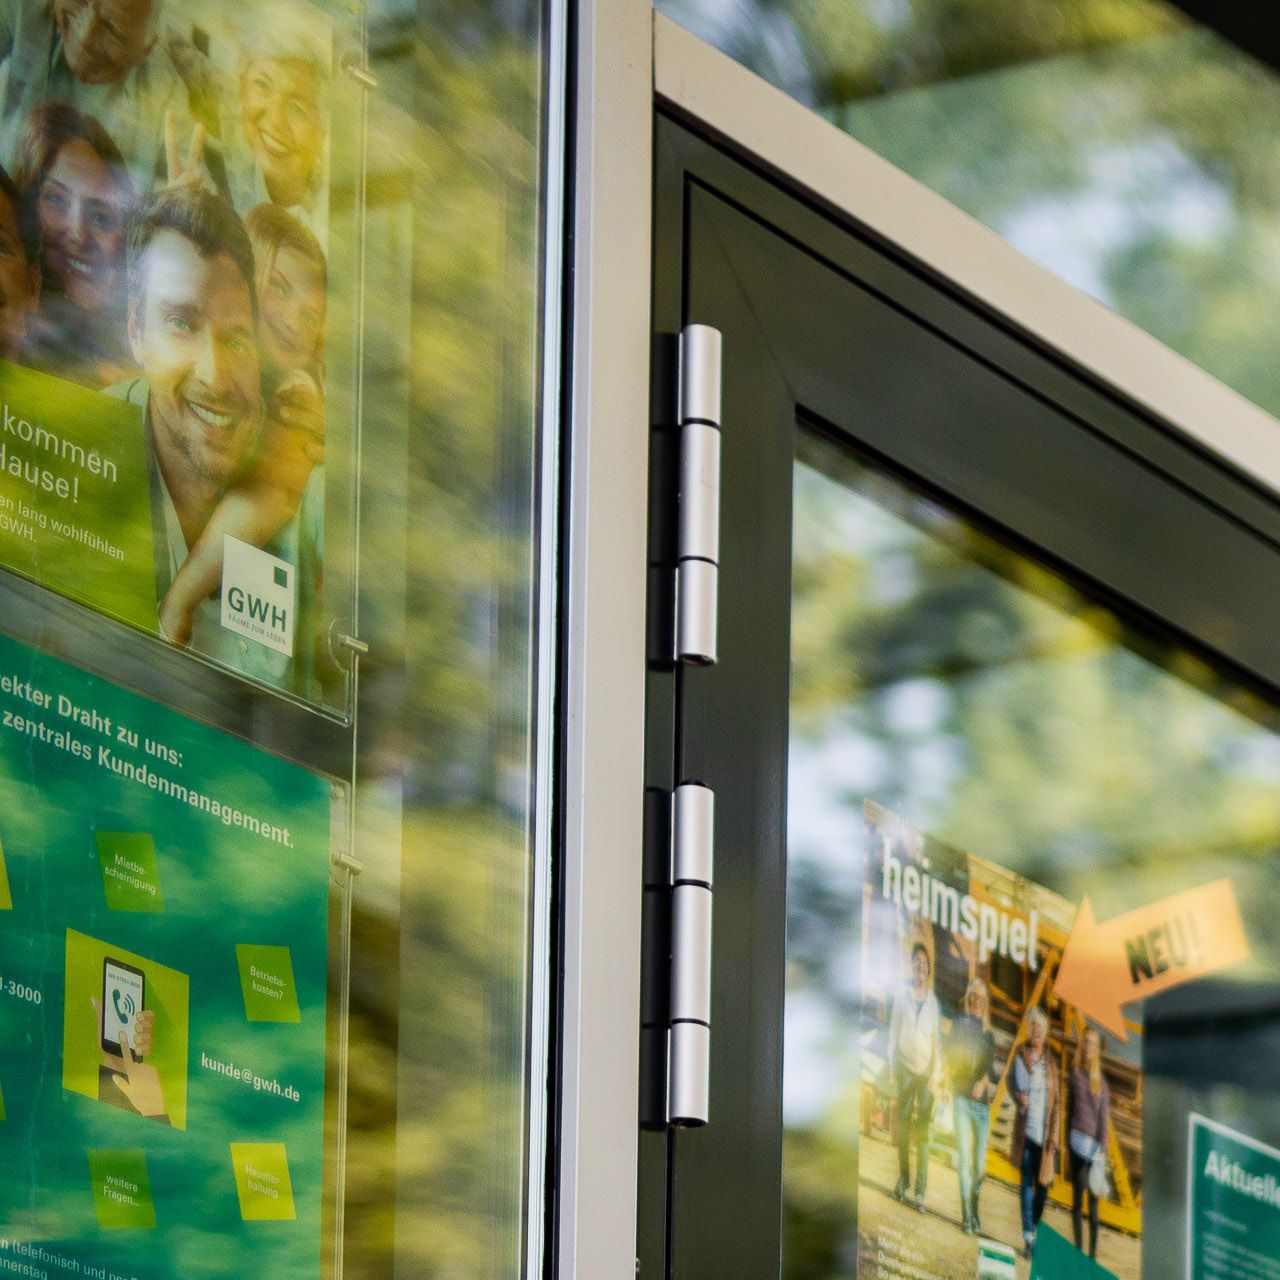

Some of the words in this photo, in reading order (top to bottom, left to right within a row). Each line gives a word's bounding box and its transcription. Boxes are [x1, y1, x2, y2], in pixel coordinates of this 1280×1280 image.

[0, 514, 38, 543] GWH.
[18, 501, 47, 528] lang
[51, 518, 124, 561] wohlfühlen
[227, 586, 287, 633] GWH
[0, 674, 52, 709] ekter
[58, 693, 112, 737] Draht
[117, 725, 139, 749] zu
[145, 737, 184, 768] uns:
[2, 709, 92, 762] zentrales
[98, 747, 294, 849] Kundenmanagement.
[881, 836, 1039, 972] heimspiel
[1123, 907, 1203, 985] NEU!
[201, 1053, 300, 1103] kunde@gwh.de
[12, 1239, 80, 1273] (telefonisch
[84, 1264, 105, 1280] und
